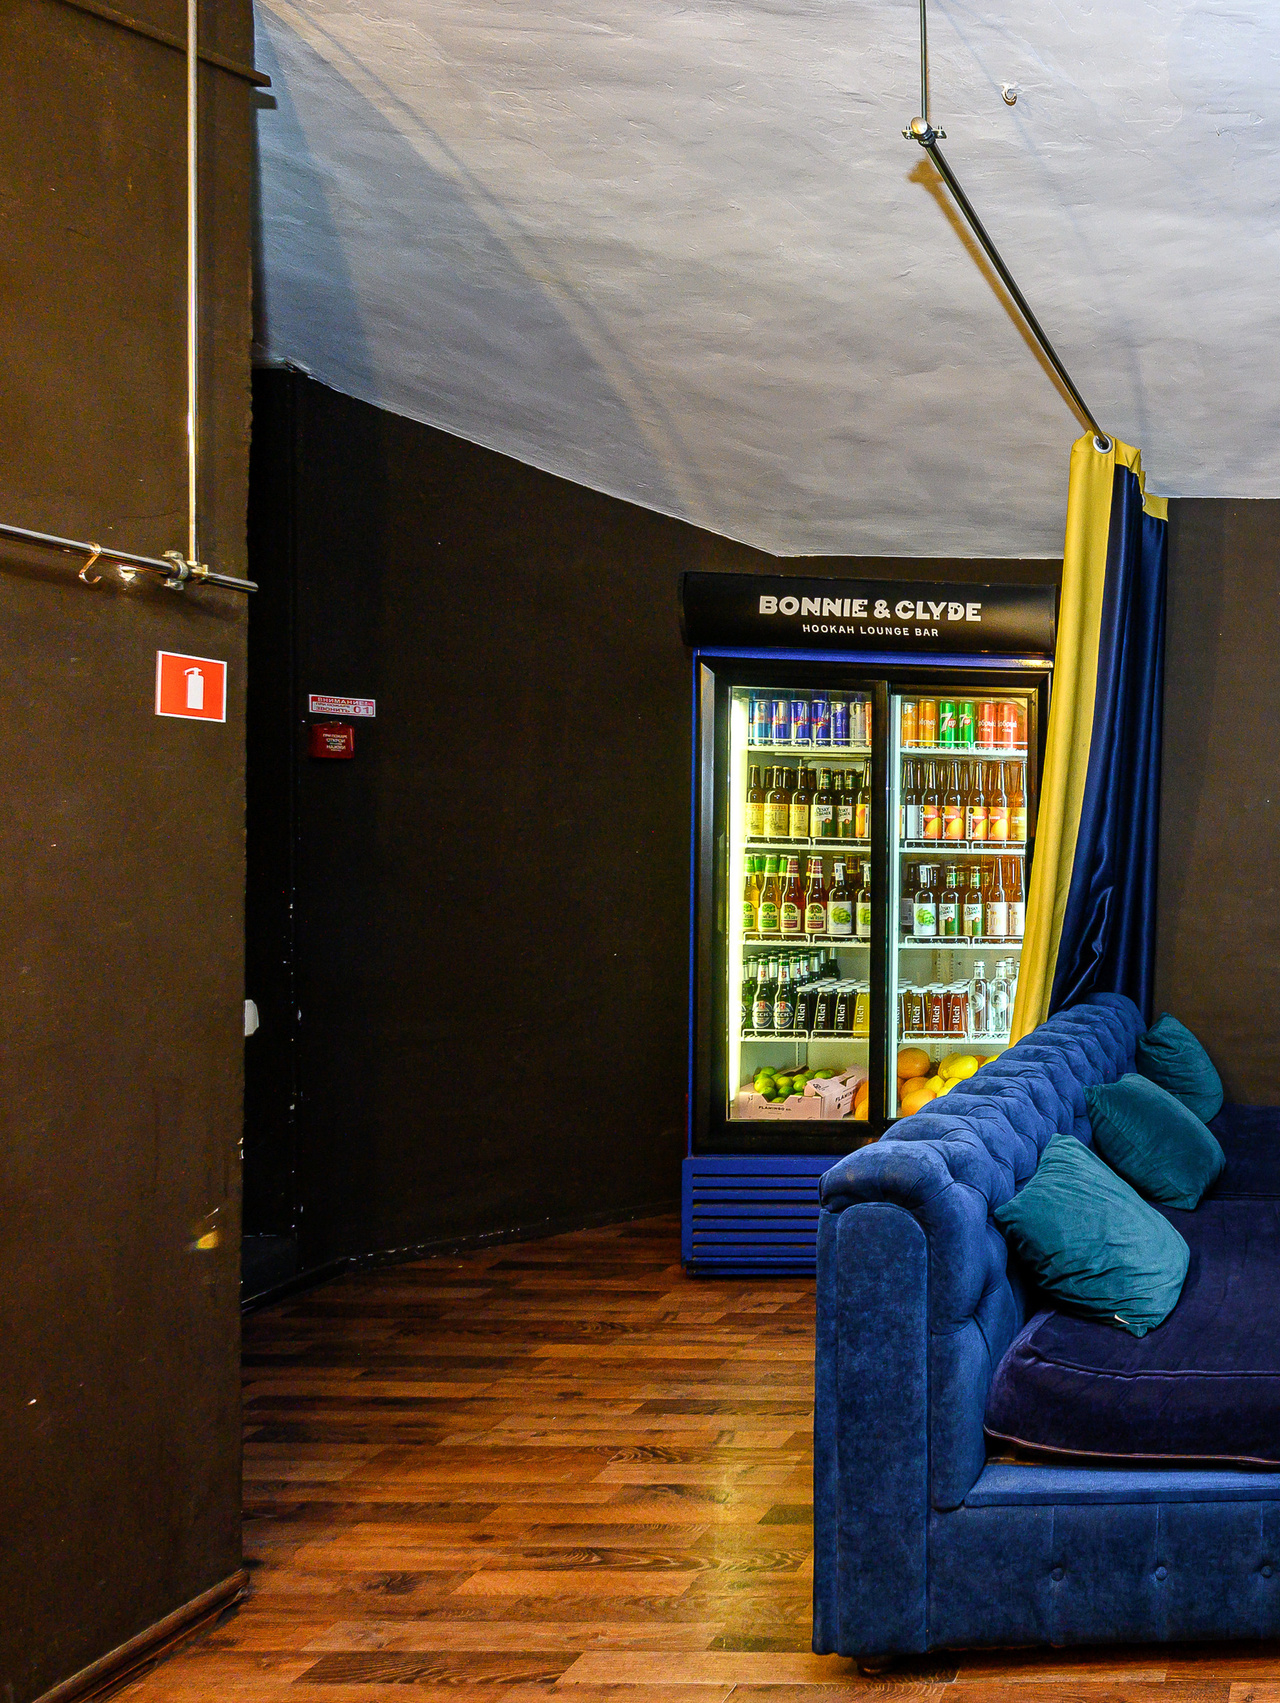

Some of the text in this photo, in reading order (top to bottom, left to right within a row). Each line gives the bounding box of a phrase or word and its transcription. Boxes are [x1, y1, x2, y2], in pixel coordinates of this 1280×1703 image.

[759, 595, 982, 622] BONNIE & CLYDE
[802, 624, 939, 637] HOOKAH LOUNGE BAR
[353, 706, 369, 714] 01
[797, 1003, 805, 1021] Rich
[818, 1003, 826, 1021] Rich
[837, 1003, 845, 1022] Rich
[856, 1005, 864, 1023] Rich
[912, 1005, 920, 1023] Rich
[932, 1005, 940, 1023] Rich
[952, 1005, 960, 1023] Rich
